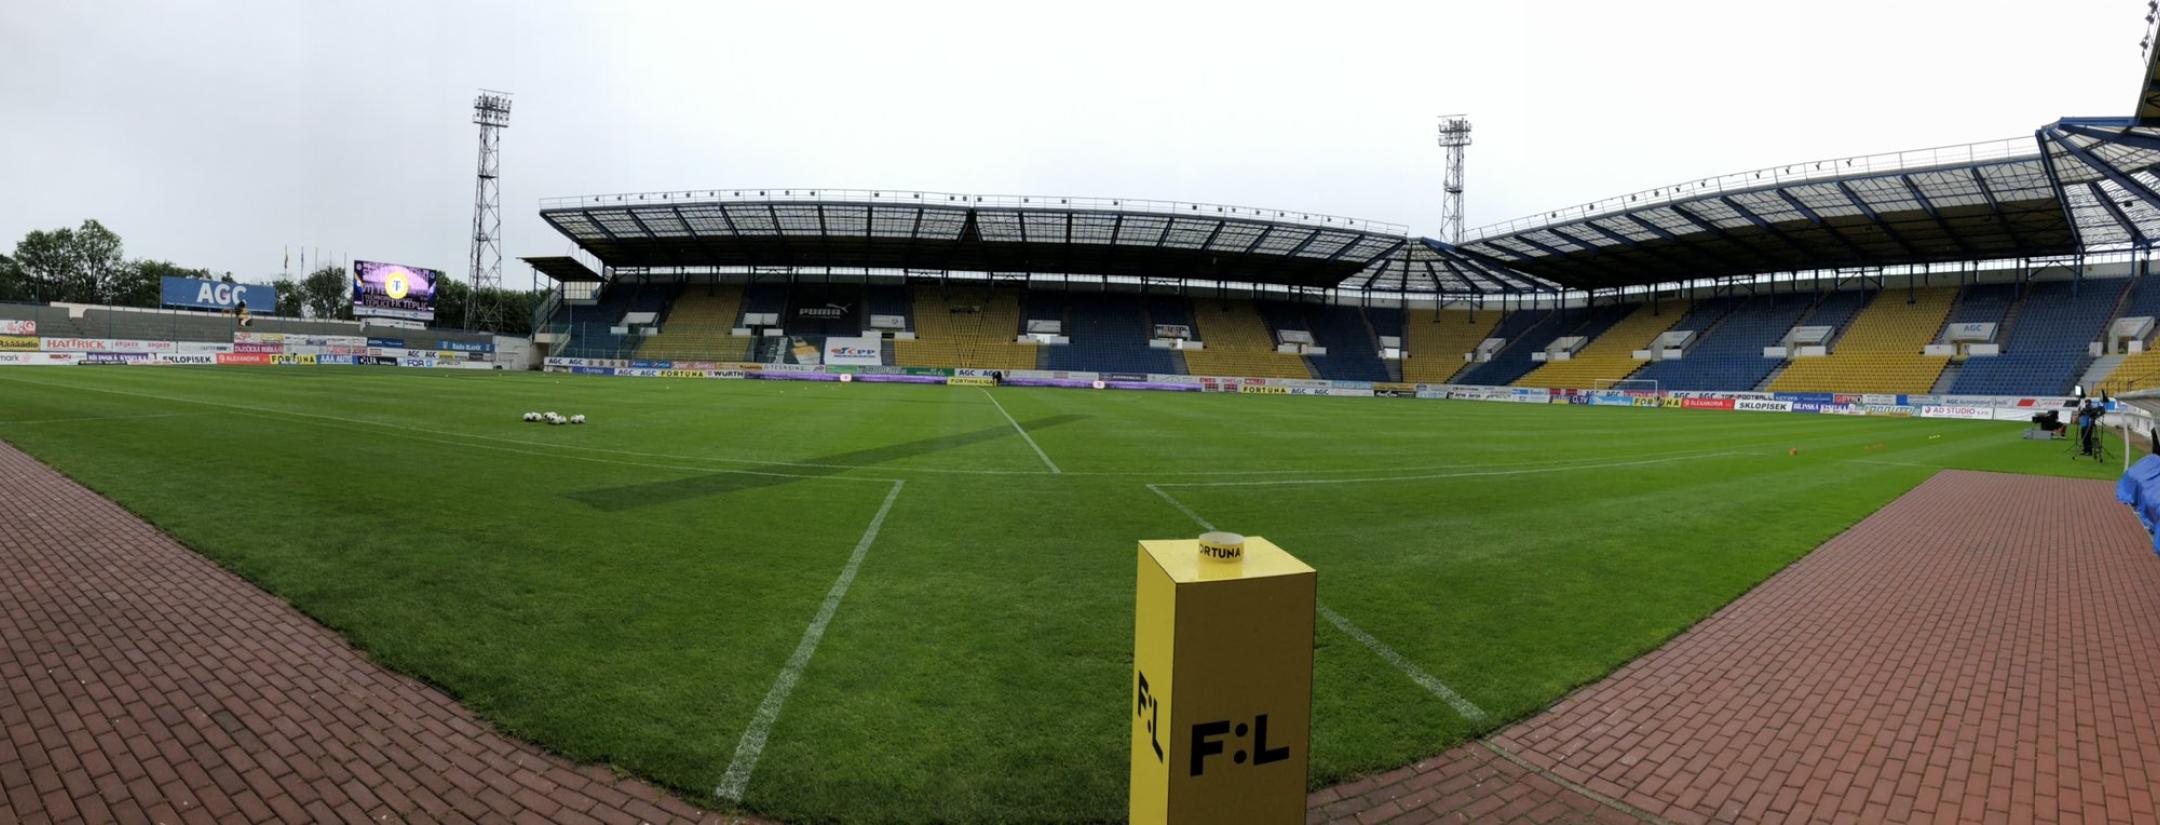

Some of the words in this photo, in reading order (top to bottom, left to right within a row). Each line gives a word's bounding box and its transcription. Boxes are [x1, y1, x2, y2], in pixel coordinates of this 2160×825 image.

[196, 282, 247, 306] AGC
[47, 339, 106, 350] HATTRICK
[640, 369, 656, 377] AGC
[1243, 386, 1286, 394] FORTUNA
[1138, 669, 1164, 765] F:L
[1189, 714, 1290, 777] F:L
